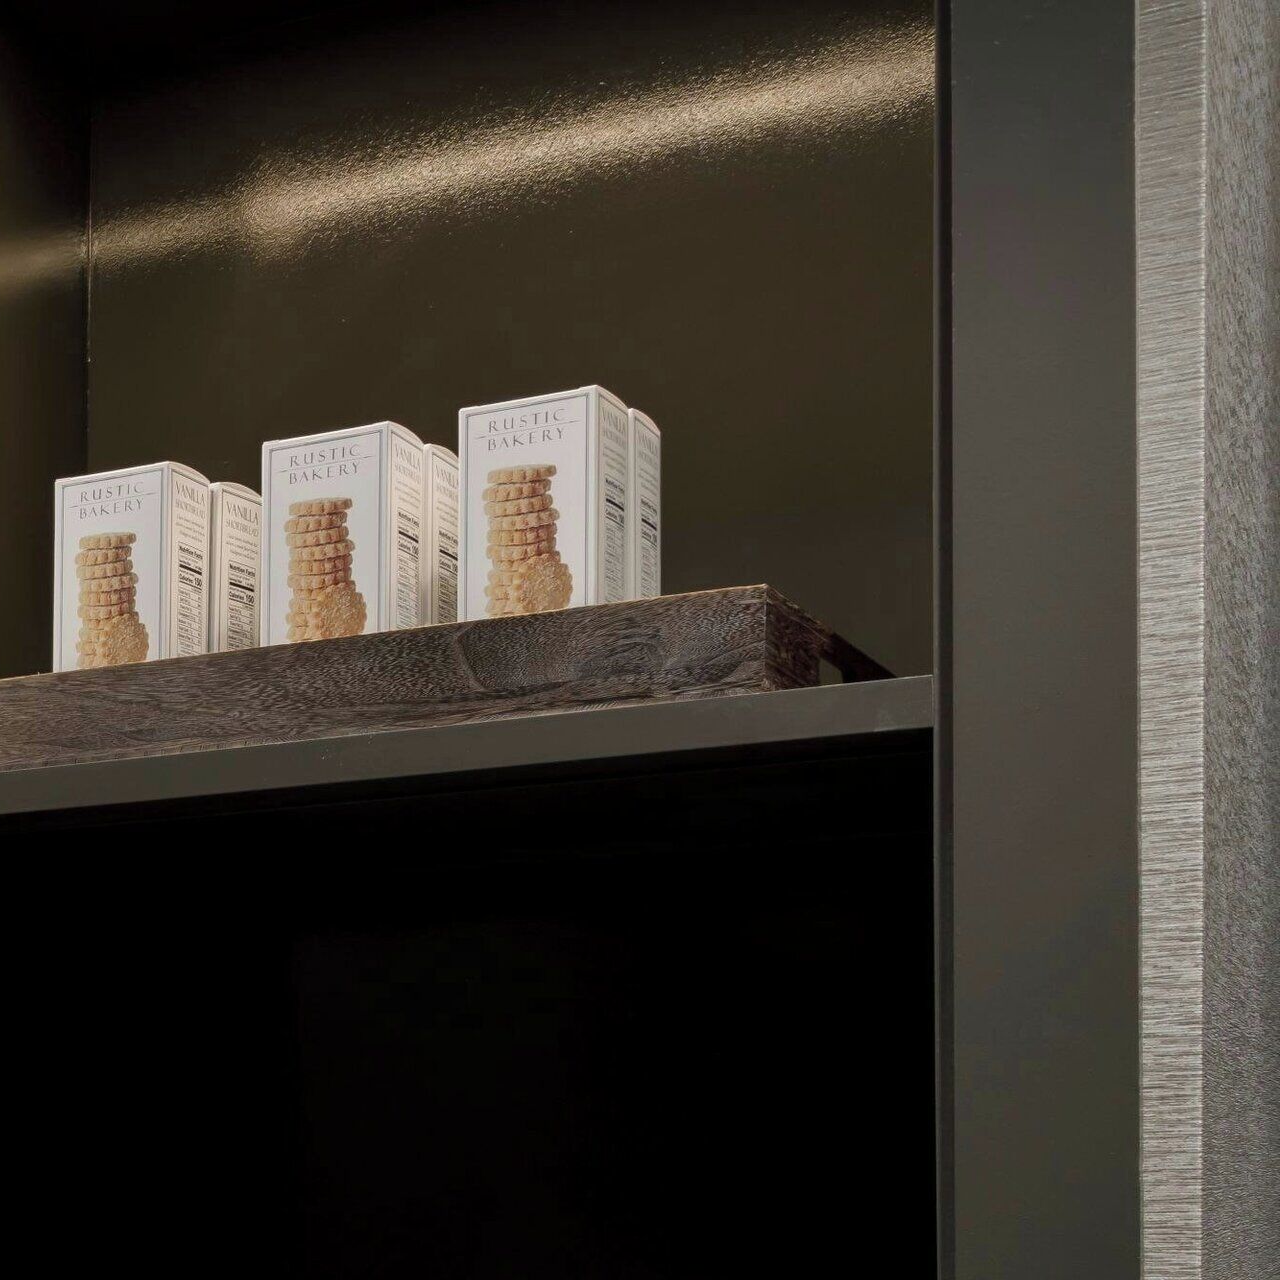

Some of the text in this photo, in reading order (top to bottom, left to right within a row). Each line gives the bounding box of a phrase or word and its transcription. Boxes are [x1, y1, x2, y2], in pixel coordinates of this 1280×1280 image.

[488, 408, 566, 433] RUSTIC
[487, 427, 565, 451] BAKERY
[290, 444, 361, 468] RUSTIC
[289, 461, 361, 485] BAKERY
[80, 481, 145, 504] RUSTIC
[174, 479, 206, 506] VANILLA
[79, 498, 145, 520] BAKERY
[227, 501, 260, 526] VANILLA
